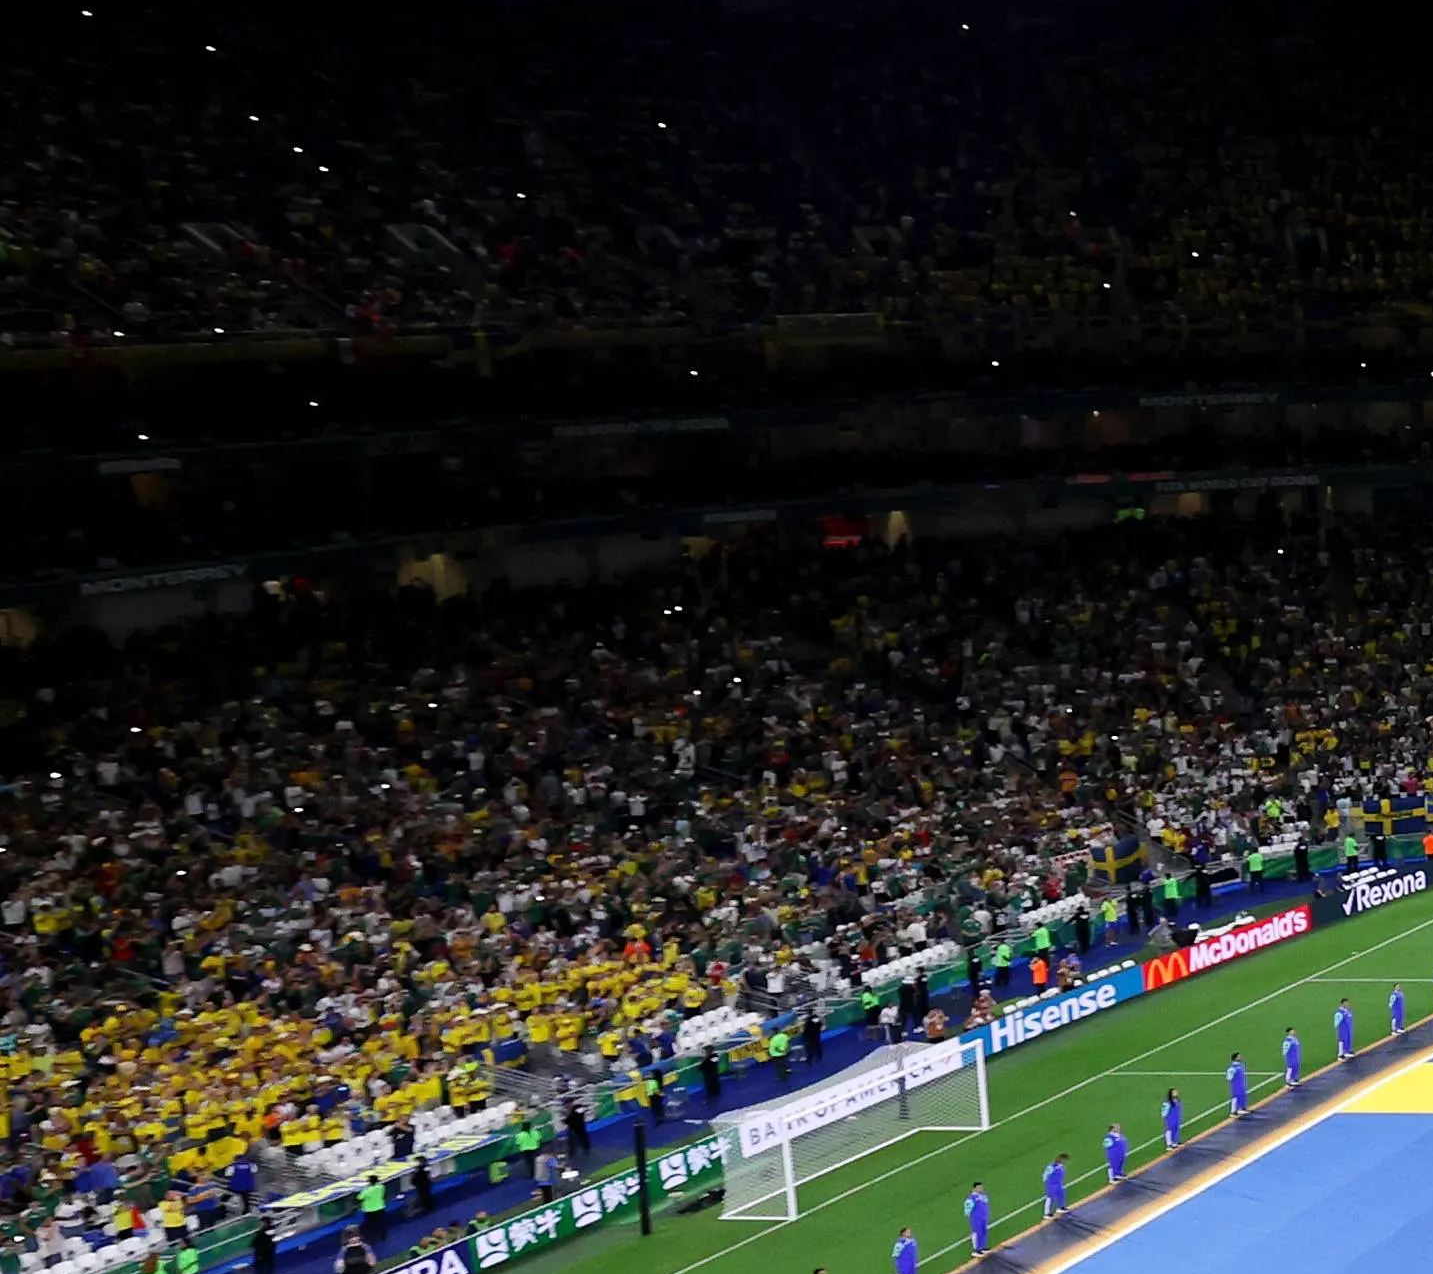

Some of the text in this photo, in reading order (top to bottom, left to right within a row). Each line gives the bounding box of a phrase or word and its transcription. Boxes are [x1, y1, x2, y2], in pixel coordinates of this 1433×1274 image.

[1356, 869, 1426, 912] Rexona
[1189, 909, 1308, 974] McDonald's
[991, 982, 1117, 1054] Hisense
[509, 1203, 562, 1251] 蒙牛
